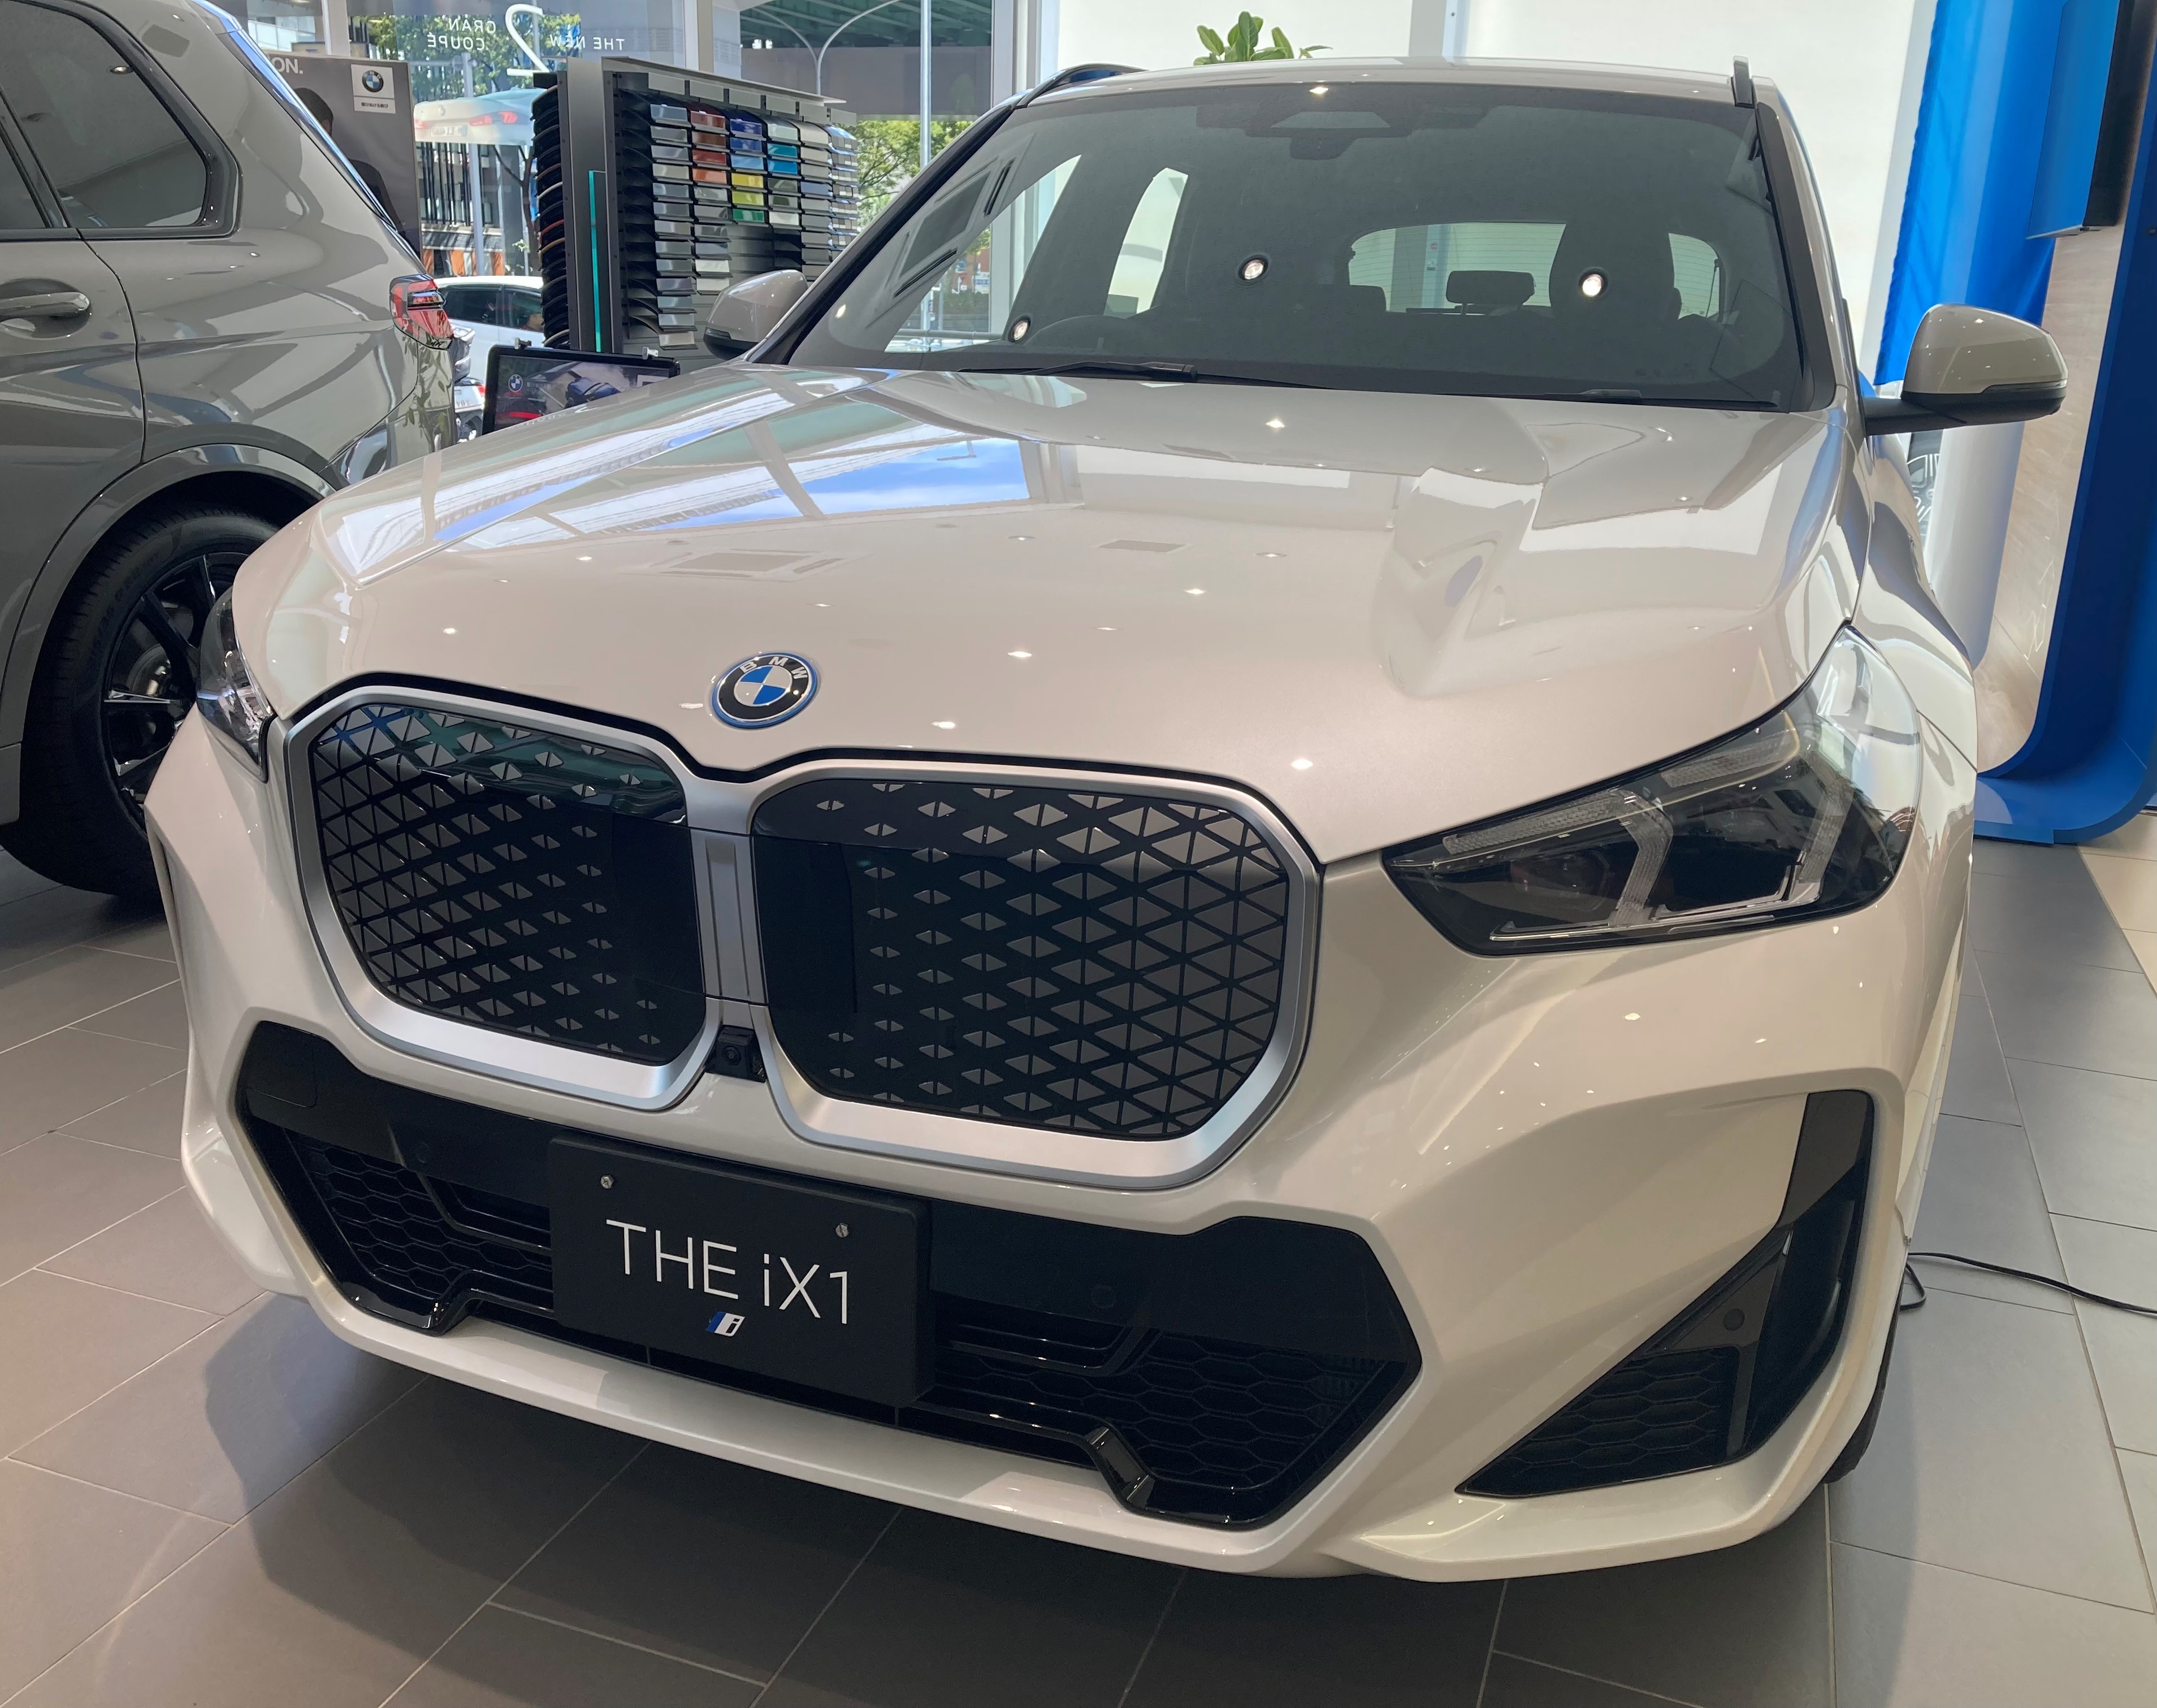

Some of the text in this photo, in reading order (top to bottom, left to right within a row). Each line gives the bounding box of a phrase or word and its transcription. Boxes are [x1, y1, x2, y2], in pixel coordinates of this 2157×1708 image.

[739, 656, 808, 679] BMW
[606, 1219, 847, 1325] THE iX1
